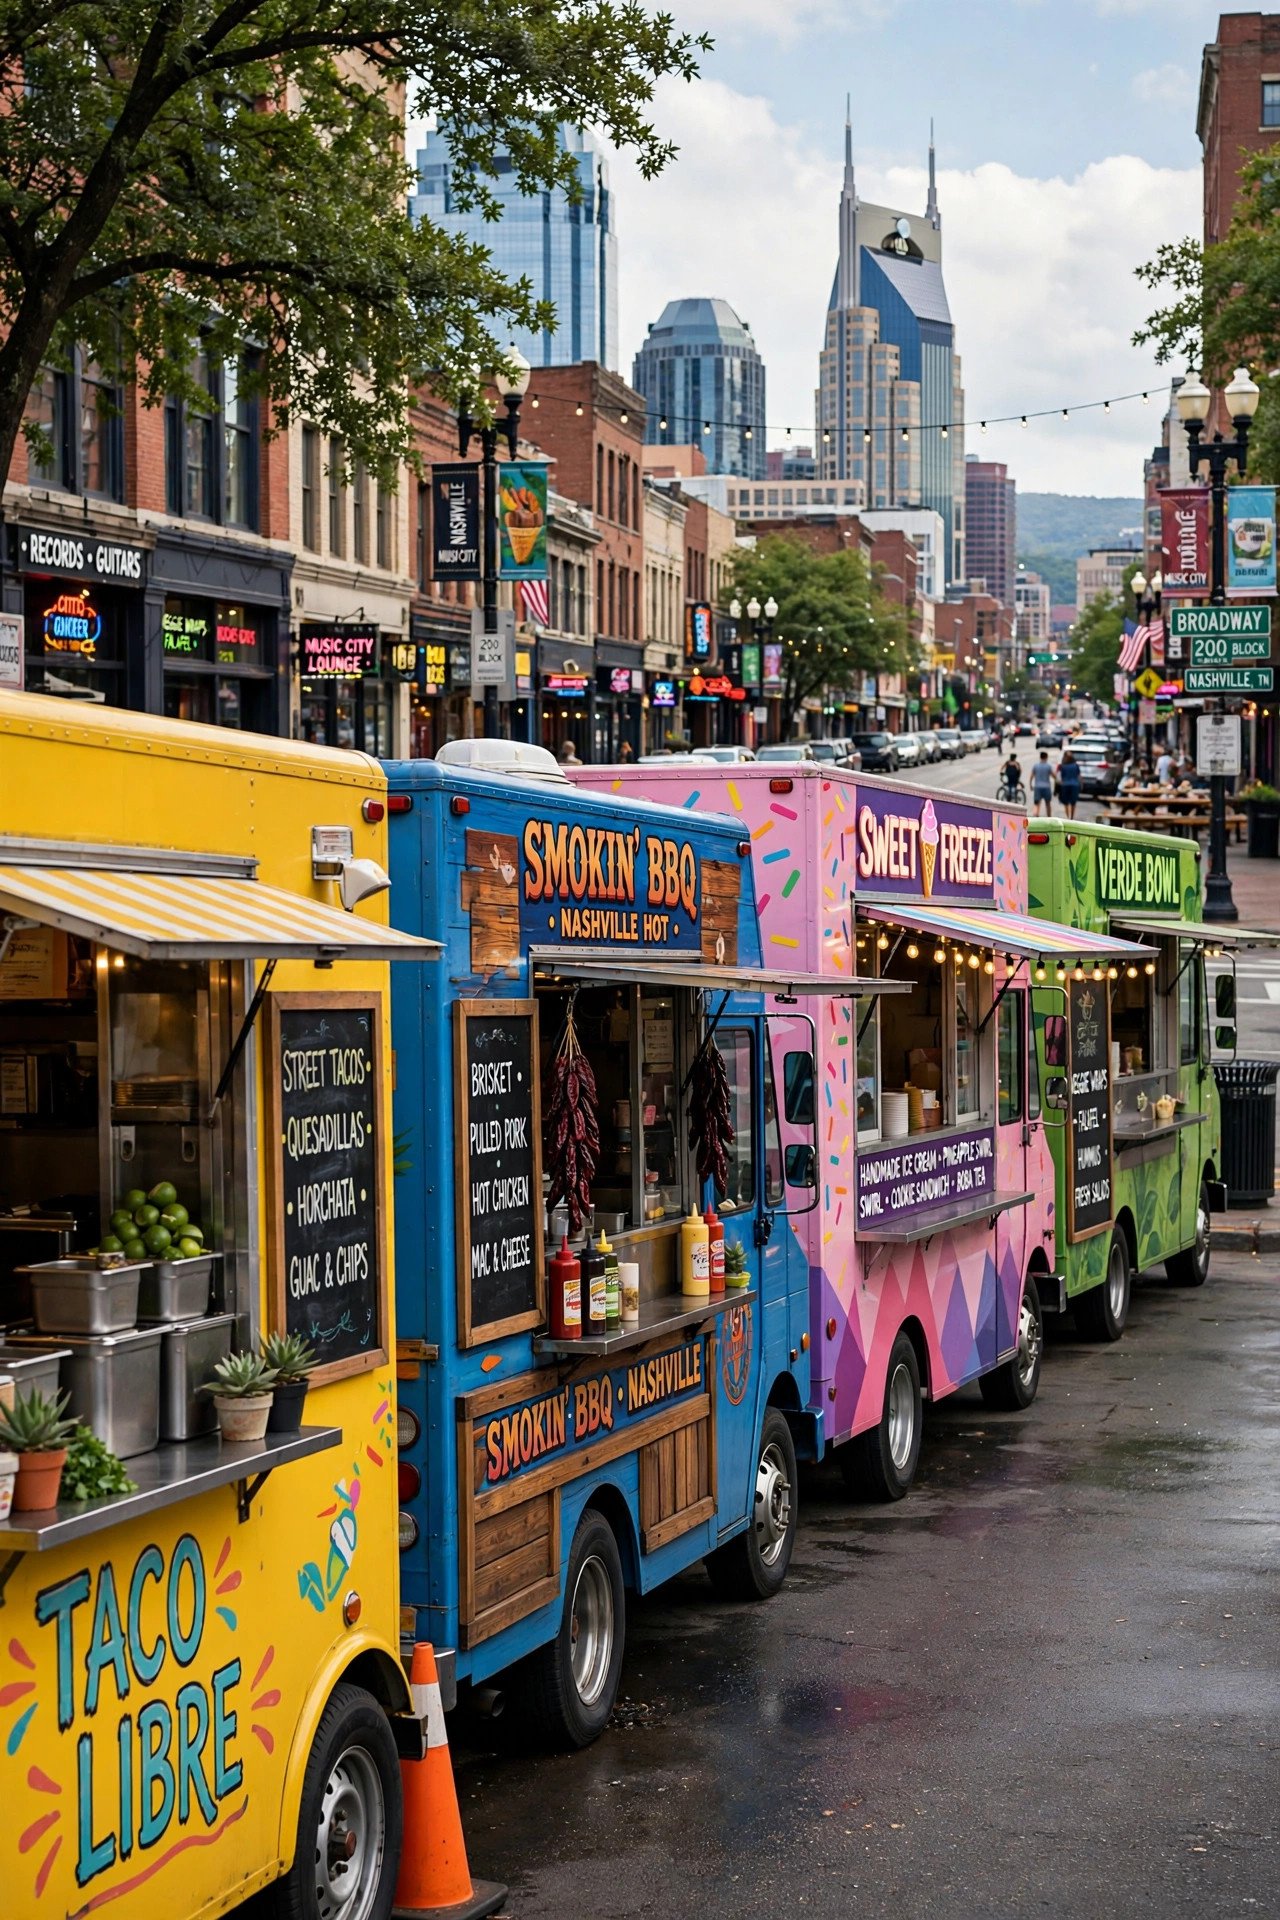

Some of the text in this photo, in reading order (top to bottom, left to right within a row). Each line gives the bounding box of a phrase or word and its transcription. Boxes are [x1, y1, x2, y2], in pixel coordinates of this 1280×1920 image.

[450, 482, 467, 545] NASHVILLE
[30, 534, 141, 579] RECORDS GUITARS
[1190, 573, 1207, 584] CITY
[1177, 611, 1262, 632] BROADWAY
[305, 638, 374, 655] MUSIC CITY
[308, 655, 362, 674] LOUNGE
[480, 639, 499, 650] 200
[1195, 639, 1227, 657] 200
[1232, 642, 1265, 655] BLOCK
[1189, 672, 1269, 689] NASHVILLE, TN
[860, 805, 993, 886] SWEET FREEZE
[523, 819, 698, 922] SMOKIN' BBQ
[1145, 853, 1180, 904] BOWL
[560, 907, 669, 942] NASHVILLE HOT
[282, 1048, 365, 1093] STREET TACOS
[471, 1061, 513, 1097] BRISKET
[287, 1111, 365, 1161] QUESADILLAS
[470, 1116, 528, 1155] PULLED PORK
[860, 1156, 901, 1187] HANDMADE
[902, 1154, 914, 1177] ICE
[914, 1149, 937, 1173] CREAM
[942, 1141, 975, 1168] PINEAPPLE
[297, 1177, 357, 1227] HORCHATA
[472, 1176, 529, 1216] HOT CHICKEN
[860, 1165, 986, 1218] SWIRL COOKIE SANDWICH BOBA TEA
[290, 1242, 368, 1300] GUAC & CHIPS
[471, 1234, 531, 1279] MAC & CHEESE
[575, 1374, 614, 1440] BBQ
[627, 1343, 702, 1414] NASHVILLE
[34, 1532, 206, 1734] TACO
[75, 1656, 244, 1888] LIBRE
